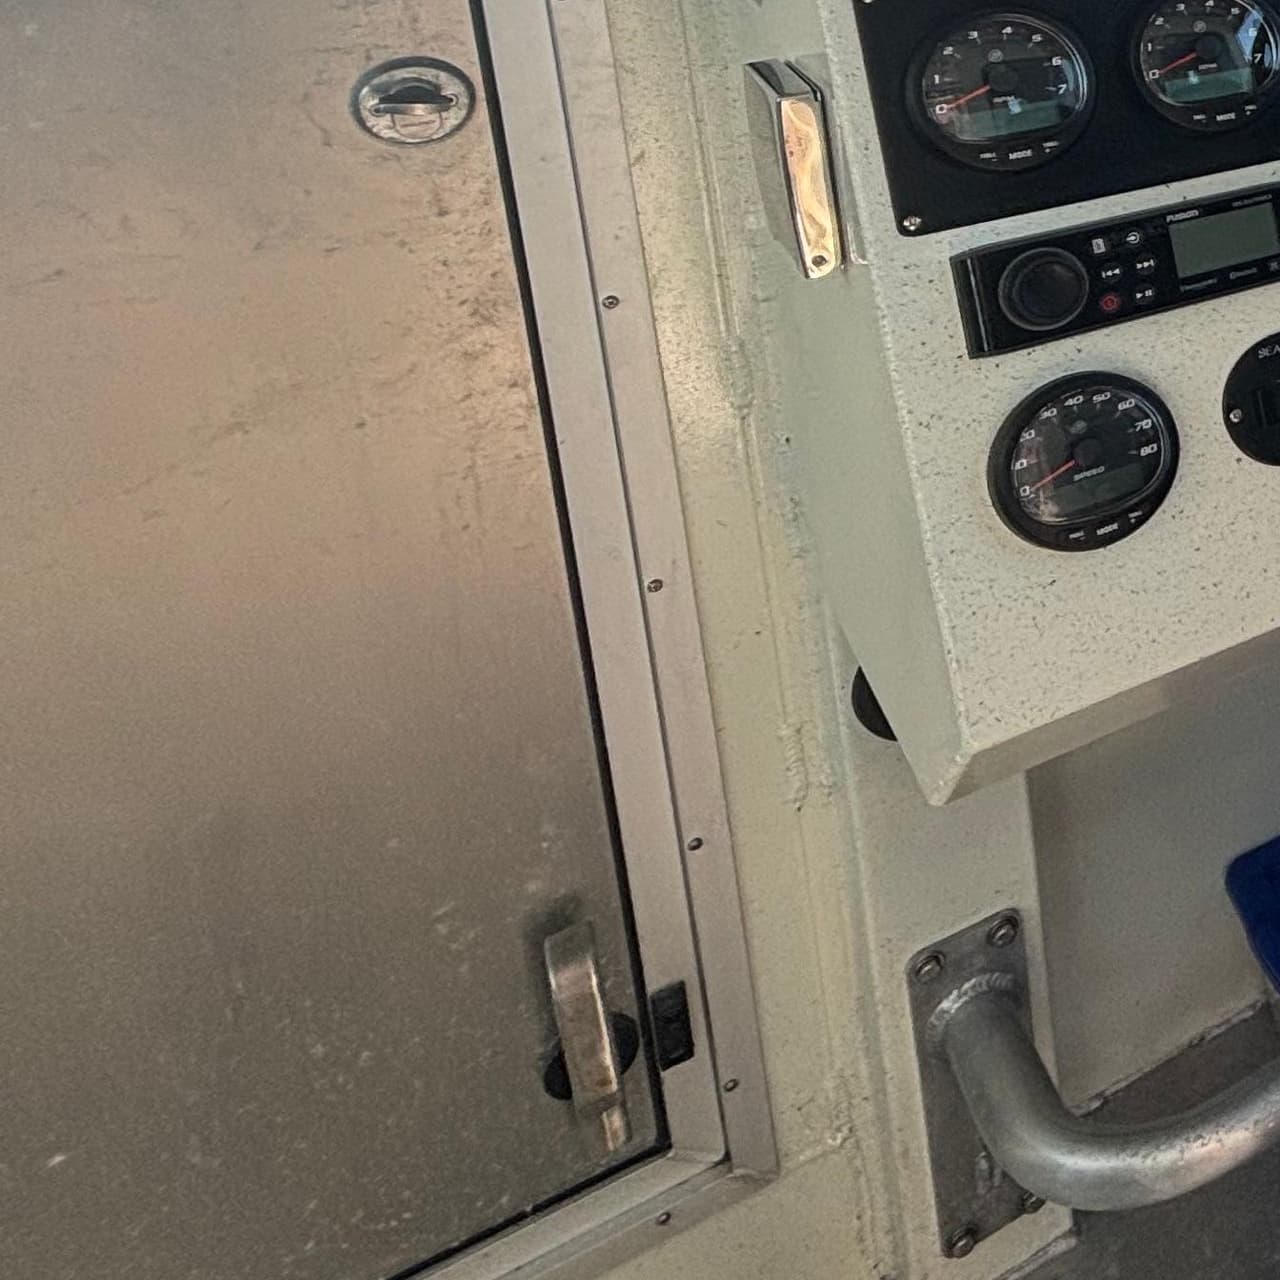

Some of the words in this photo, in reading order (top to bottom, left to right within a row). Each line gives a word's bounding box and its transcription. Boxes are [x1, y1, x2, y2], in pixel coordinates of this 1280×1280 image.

[968, 31, 978, 39] 3
[1147, 43, 1152, 51] 1
[1052, 57, 1061, 65] 6
[1254, 54, 1262, 63] 7
[1150, 70, 1159, 78] 0
[934, 75, 939, 84] 1
[1058, 84, 1067, 95] 7
[936, 104, 947, 113] 0
[1064, 396, 1083, 406] 40
[1093, 392, 1111, 403] 50
[1118, 399, 1135, 410] 60
[1039, 408, 1057, 419] 30
[1135, 419, 1151, 431] 70
[1140, 444, 1158, 456] 80
[1073, 466, 1105, 481] SPEED
[1020, 486, 1030, 496] 0
